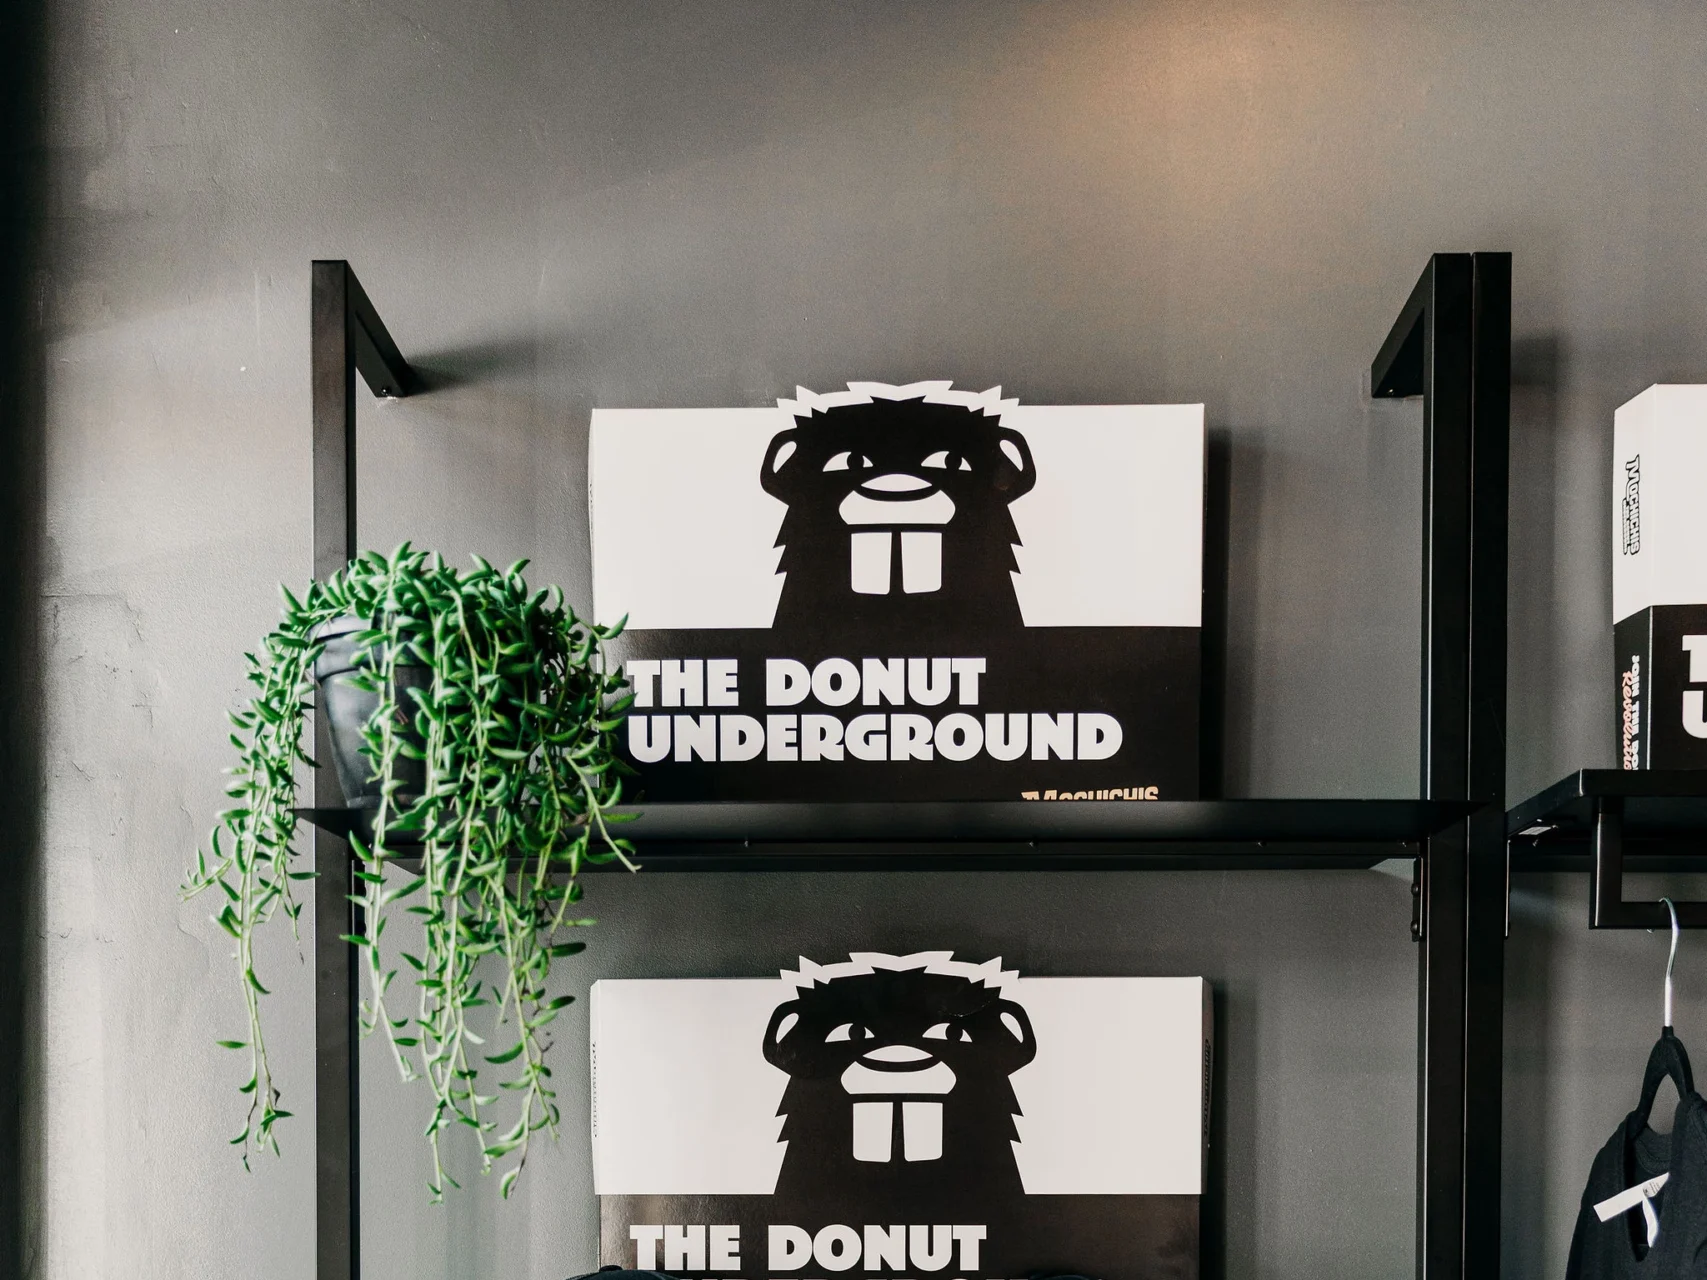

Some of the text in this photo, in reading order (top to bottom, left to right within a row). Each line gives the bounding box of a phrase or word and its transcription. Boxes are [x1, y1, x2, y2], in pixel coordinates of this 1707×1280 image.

[626, 657, 987, 707] THE DONUT
[627, 712, 1123, 763] UNDERGROUND
[629, 1224, 987, 1272] THE DONUT
